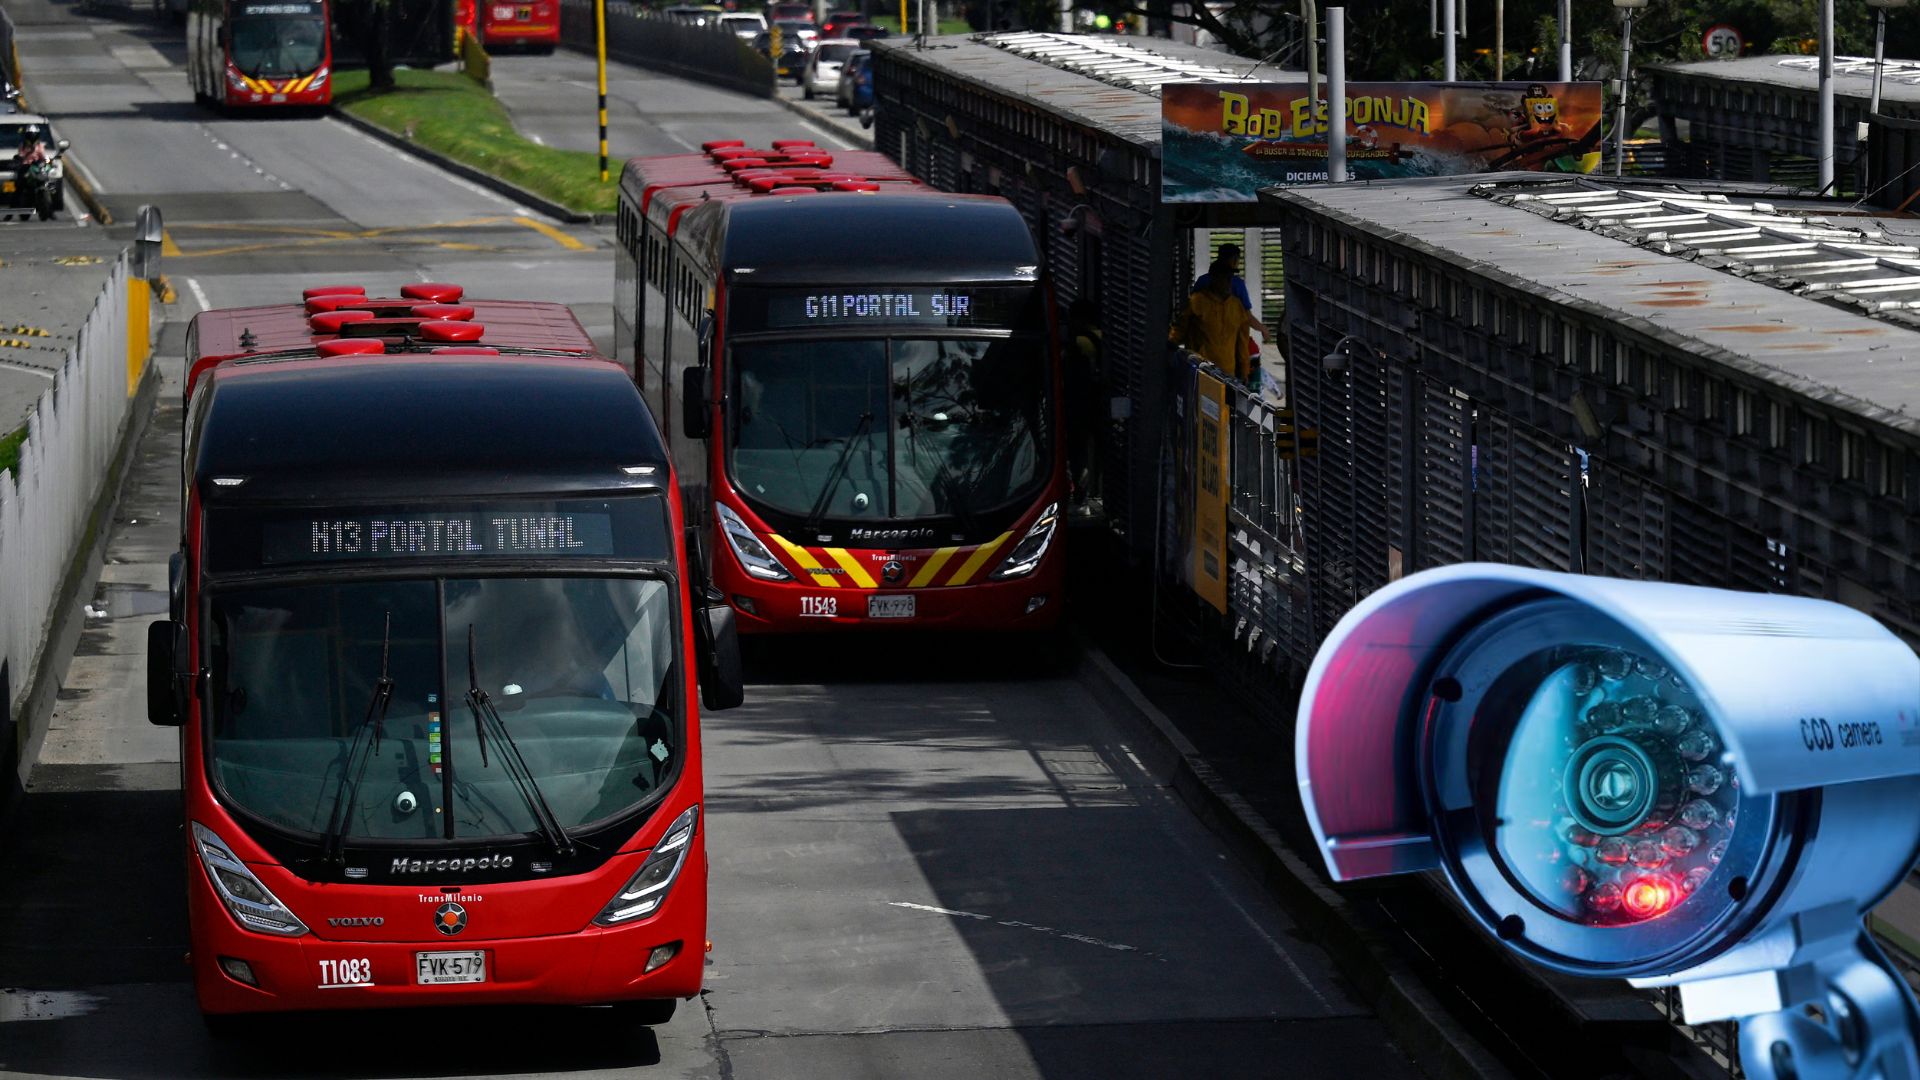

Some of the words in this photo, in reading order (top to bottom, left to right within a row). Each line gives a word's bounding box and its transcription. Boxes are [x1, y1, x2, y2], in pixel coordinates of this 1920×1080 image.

[1711, 35, 1737, 54] 50
[1286, 172, 1329, 181] DICIEMB
[805, 295, 837, 318] G11
[843, 294, 920, 317] PORTAL
[931, 294, 970, 316] SUR
[312, 520, 361, 552] H13
[370, 519, 483, 552] PORTAL
[492, 516, 584, 550] TUNAL
[850, 527, 935, 540] Marcopolo
[801, 596, 837, 615] T1543
[1800, 717, 1834, 752] CCD
[1838, 720, 1883, 748] camera
[390, 853, 514, 874] Marcopolo
[418, 893, 483, 903] TransMilenio
[327, 916, 385, 927] VOLVO
[319, 958, 371, 985] T1083
[419, 957, 483, 977] FVK-579
